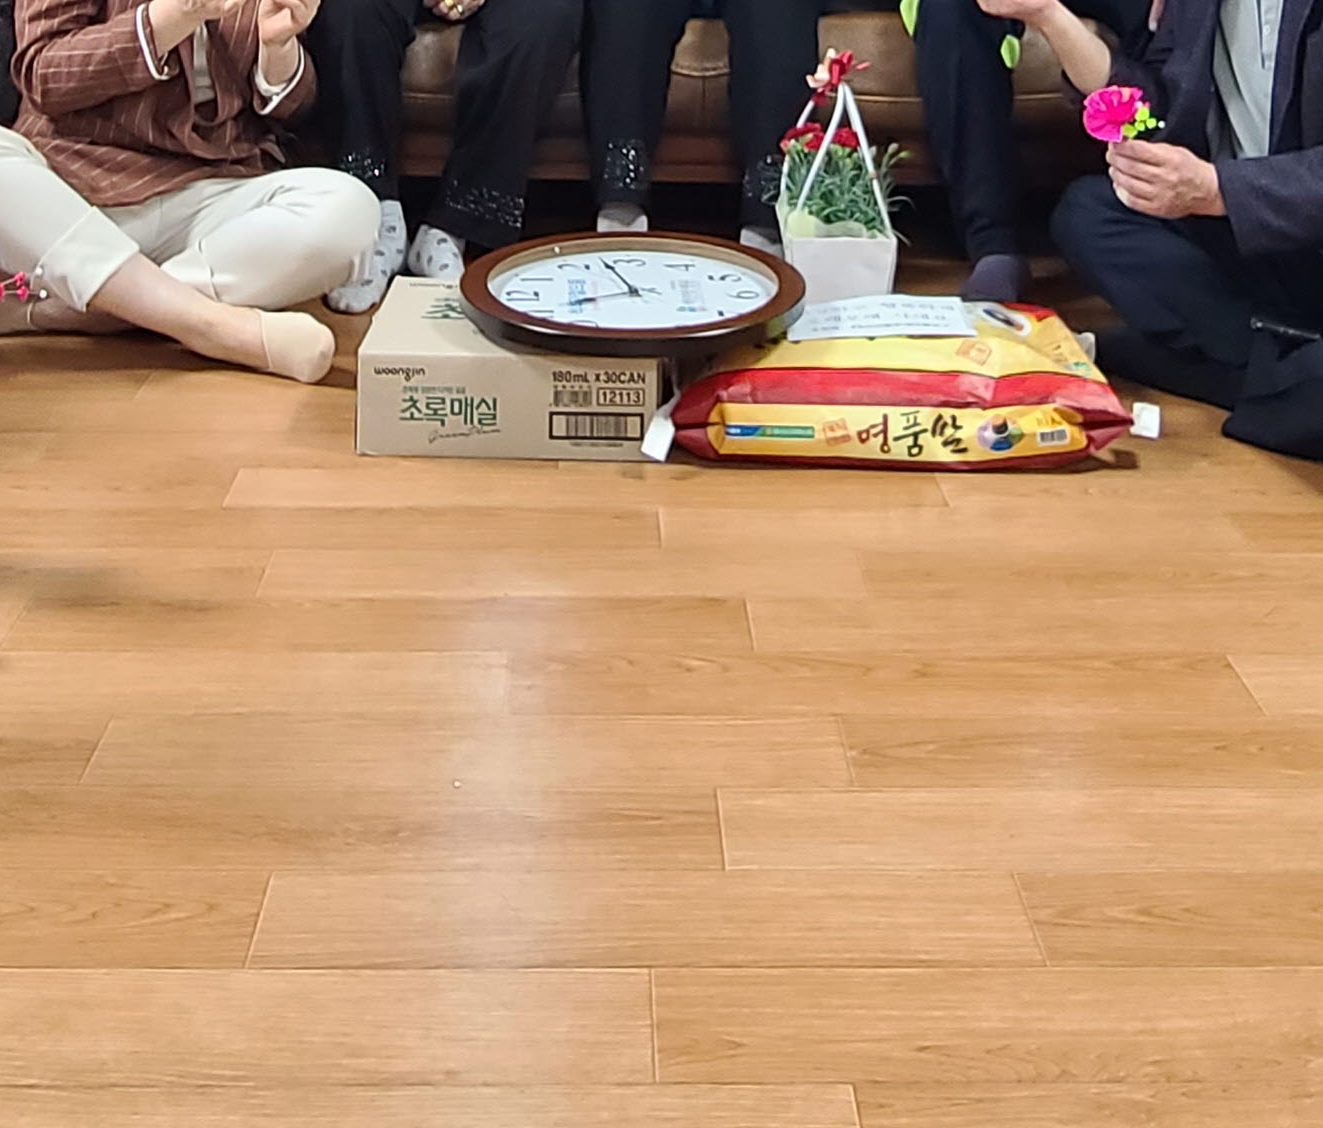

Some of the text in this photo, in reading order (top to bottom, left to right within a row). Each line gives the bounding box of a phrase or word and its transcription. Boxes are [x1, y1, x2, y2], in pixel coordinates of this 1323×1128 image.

[557, 263, 591, 271] 2
[613, 258, 646, 267] 3
[663, 263, 696, 271] 4
[708, 273, 741, 283] 5
[506, 290, 540, 302] 12
[726, 289, 759, 300] 6
[373, 367, 426, 382] woongjin
[602, 390, 641, 404] 12113
[399, 395, 497, 427] 초록매실
[856, 410, 969, 458] 명품쌀
